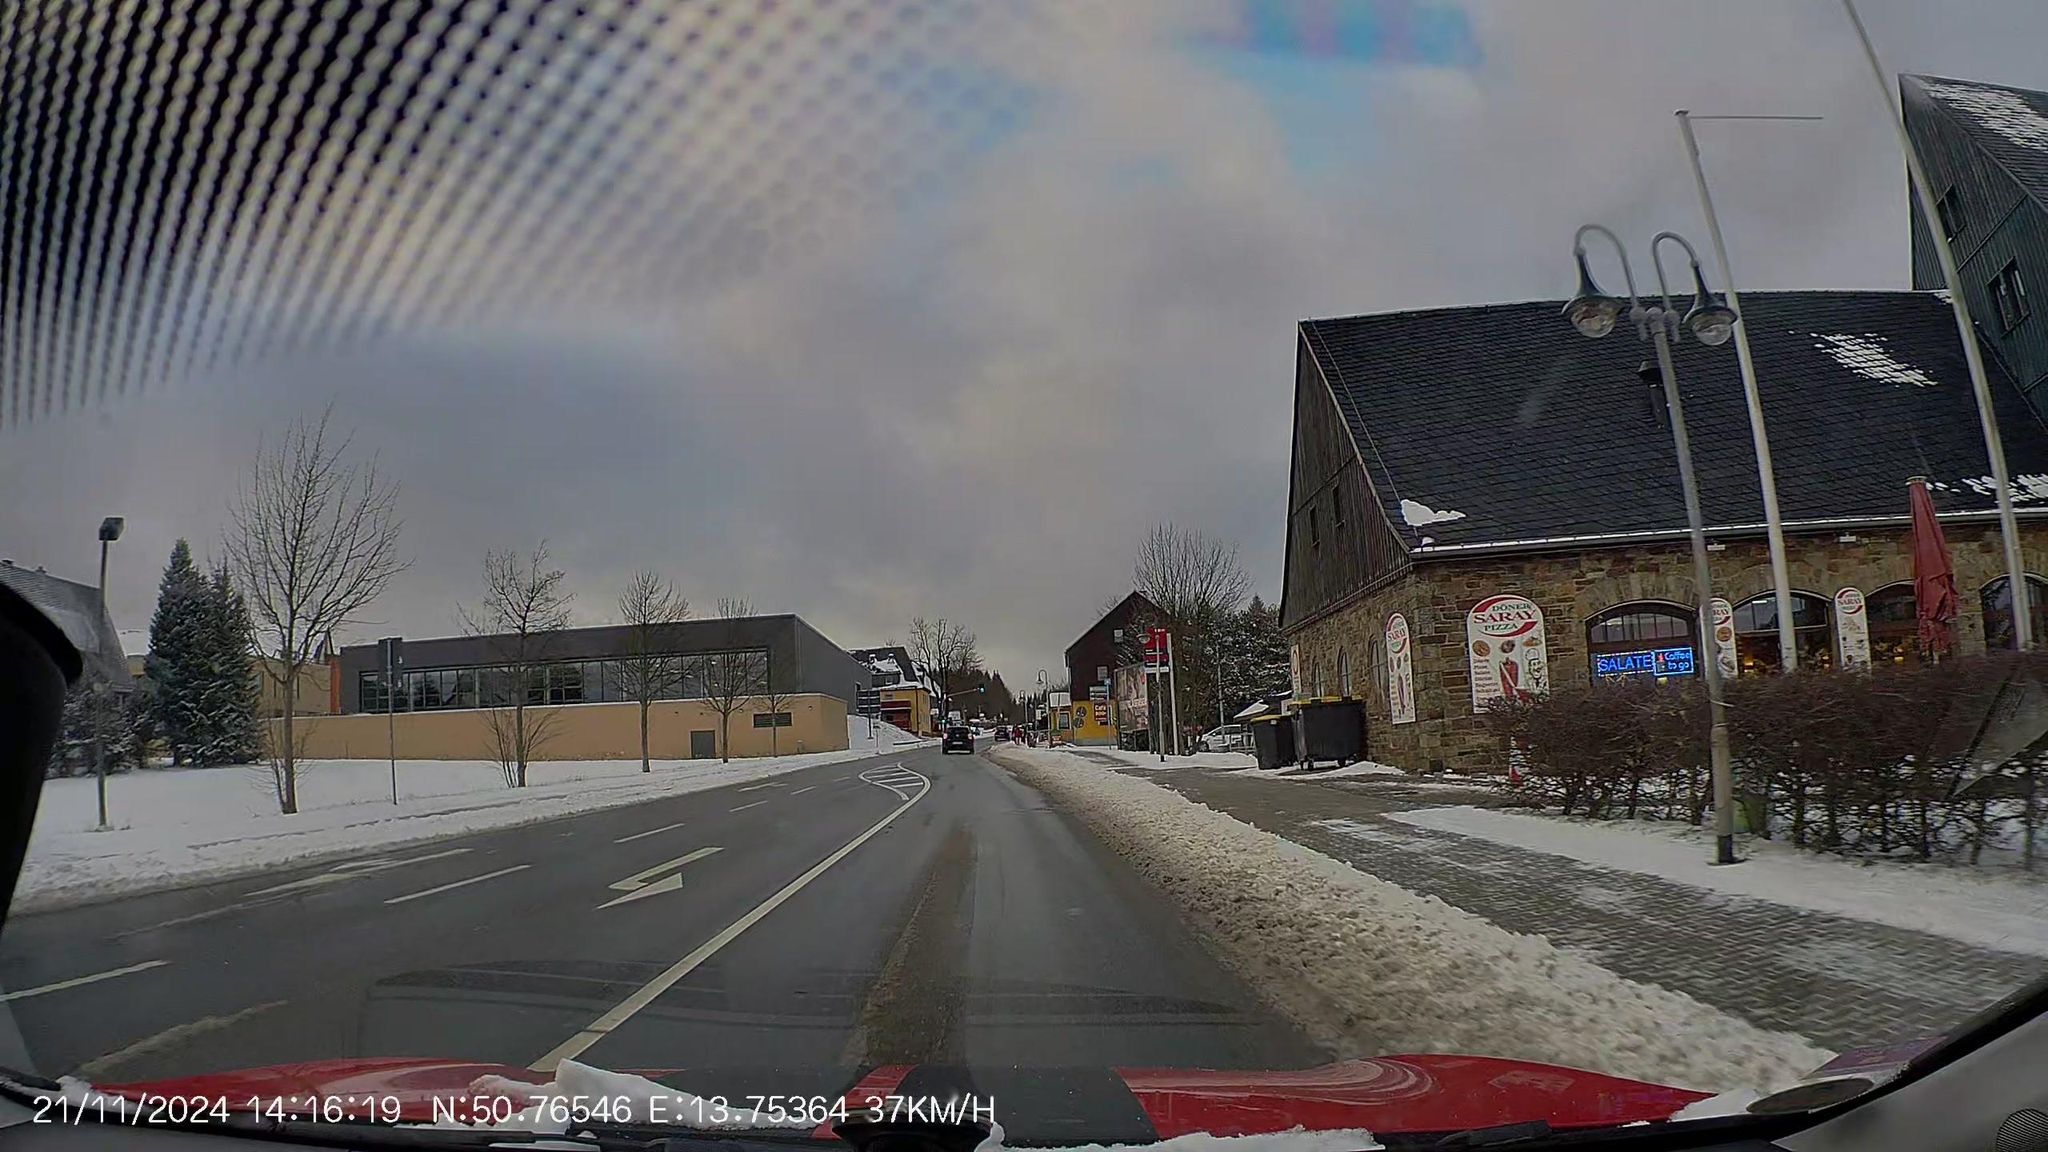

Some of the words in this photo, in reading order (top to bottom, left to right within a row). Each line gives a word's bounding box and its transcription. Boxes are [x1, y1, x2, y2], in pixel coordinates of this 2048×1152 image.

[1492, 603, 1532, 612] DÖNER
[1473, 610, 1536, 624] SARAY
[1484, 623, 1518, 632] PIZZA
[1599, 654, 1652, 672] SALATE
